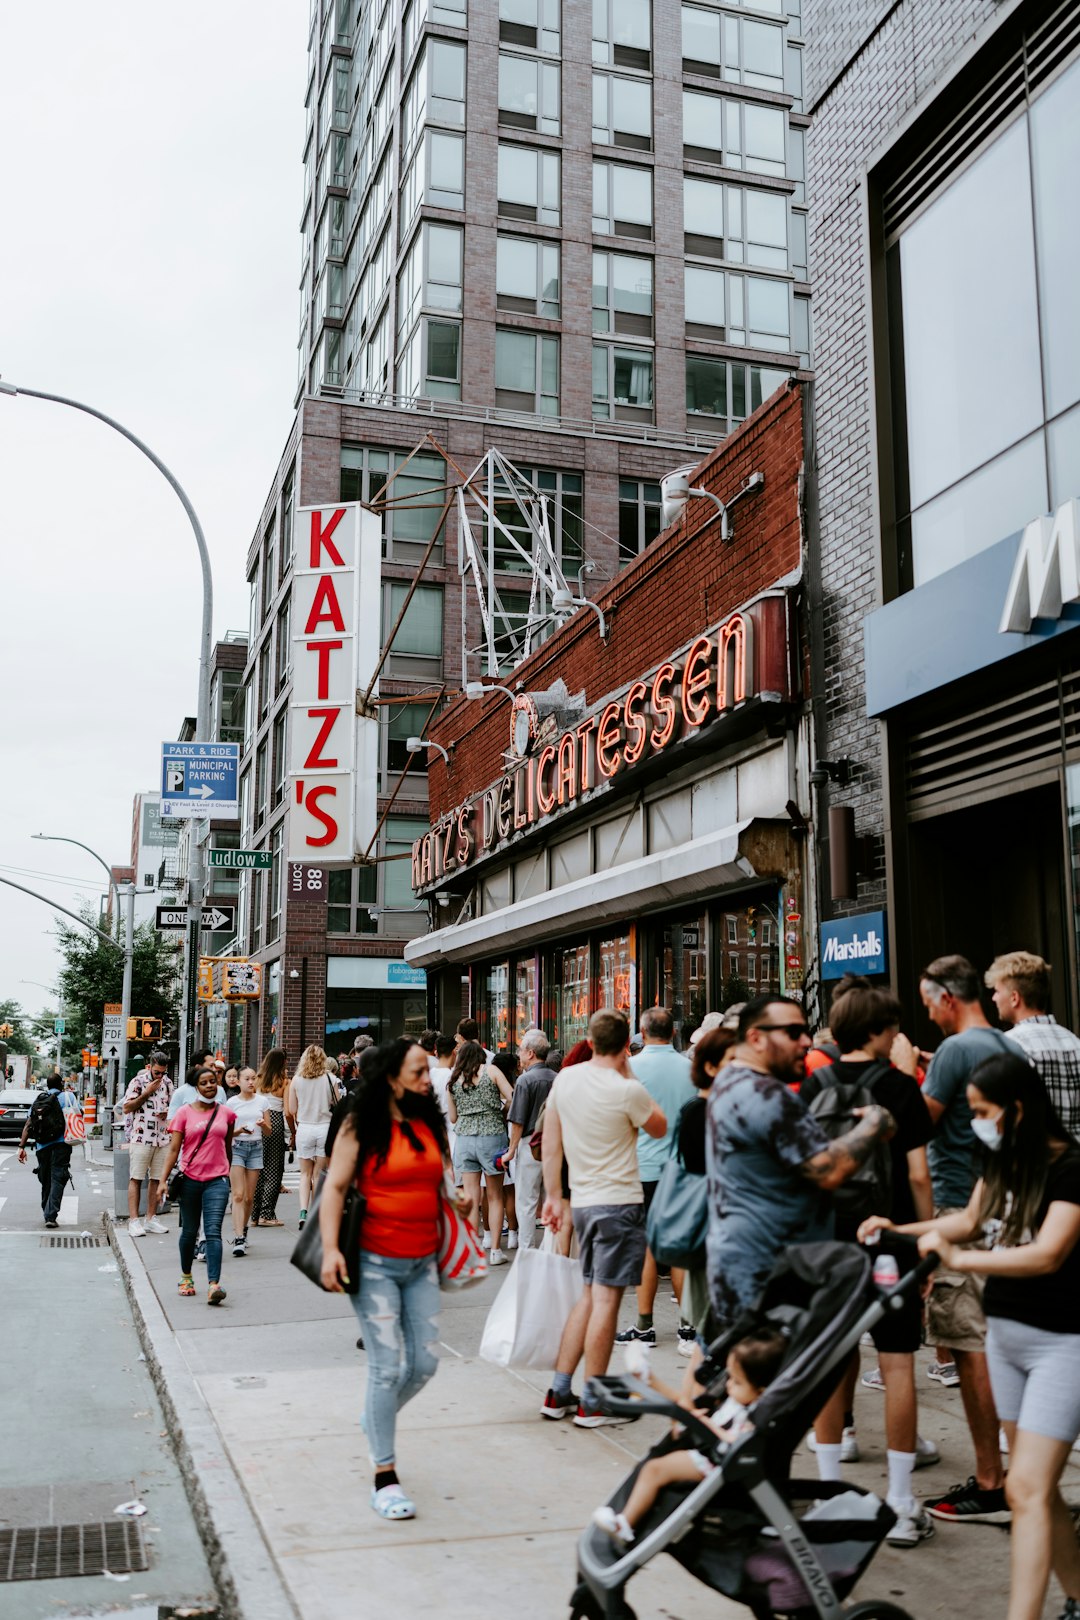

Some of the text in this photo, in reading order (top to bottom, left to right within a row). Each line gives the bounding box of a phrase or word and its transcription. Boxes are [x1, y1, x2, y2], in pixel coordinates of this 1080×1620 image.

[296, 508, 347, 848] KATZ'S
[169, 746, 231, 756] PARK & RIDE
[189, 761, 234, 771] MUNICIPAL
[189, 771, 225, 781] PARKING
[411, 805, 475, 890] KATZ'S
[209, 850, 269, 867] Ludlow St
[307, 868, 322, 890] 88
[822, 930, 882, 963] Marshalls
